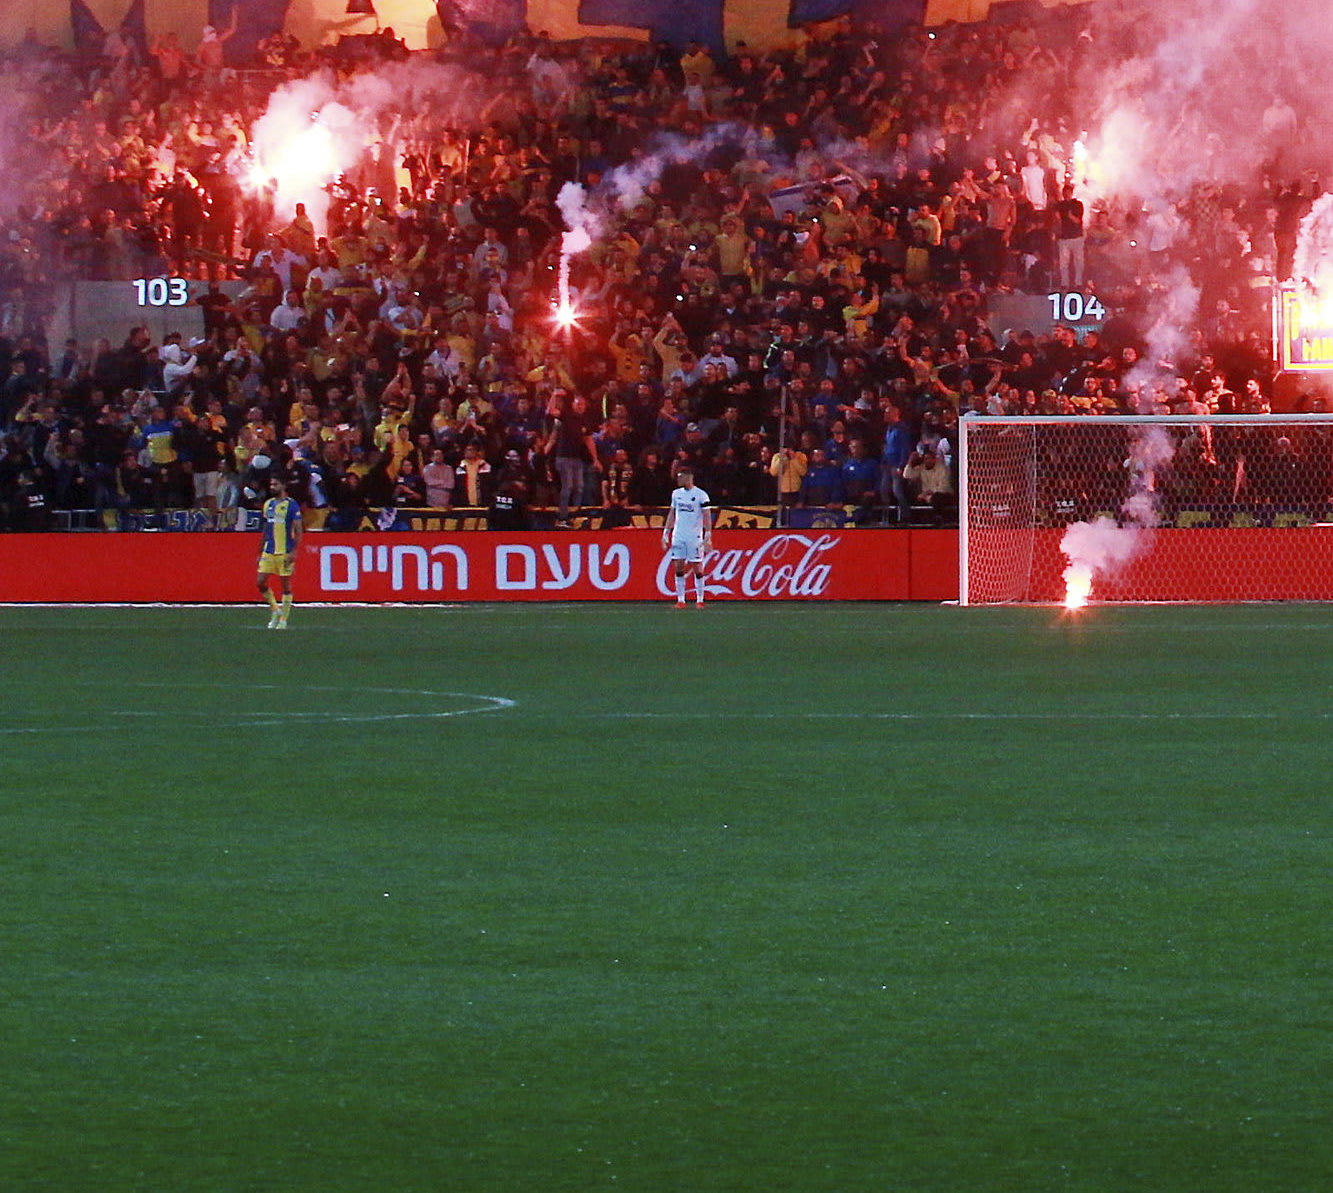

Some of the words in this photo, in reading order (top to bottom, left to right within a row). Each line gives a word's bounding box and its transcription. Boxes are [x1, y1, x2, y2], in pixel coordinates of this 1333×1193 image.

[132, 277, 188, 306] 103
[1047, 292, 1106, 321] 104
[320, 544, 468, 591] החיים
[495, 543, 631, 591] טעם
